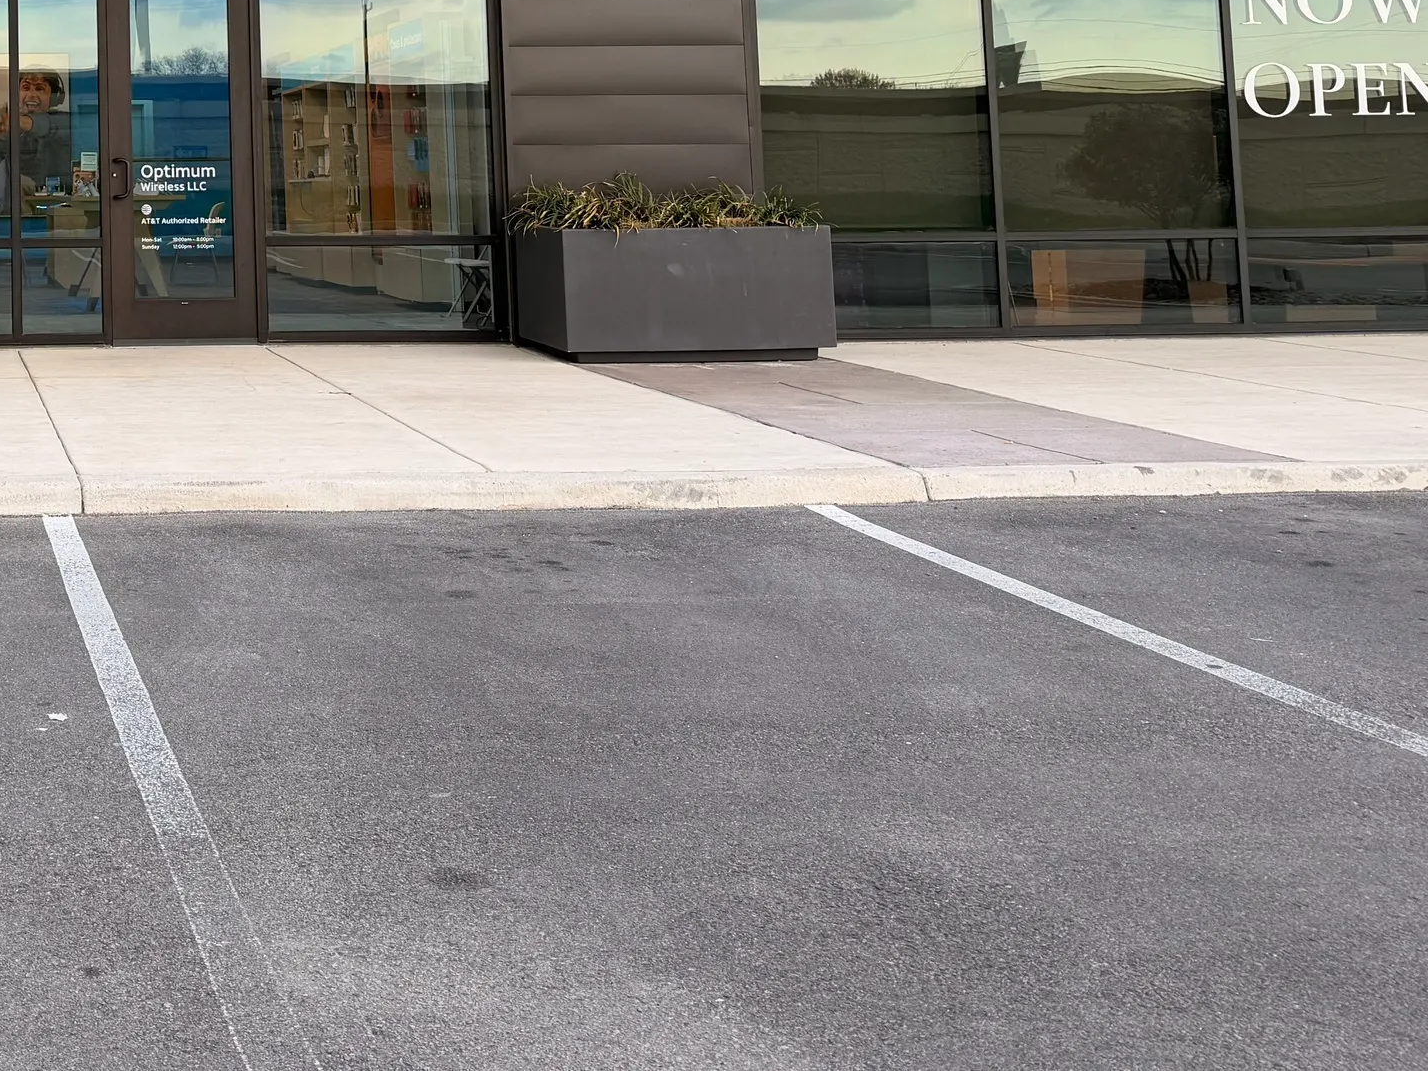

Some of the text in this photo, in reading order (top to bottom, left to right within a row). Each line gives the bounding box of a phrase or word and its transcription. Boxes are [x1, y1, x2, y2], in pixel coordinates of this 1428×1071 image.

[1243, 62, 1428, 118] OPEN
[141, 164, 216, 182] Optimum
[140, 181, 207, 192] Wireless LLC
